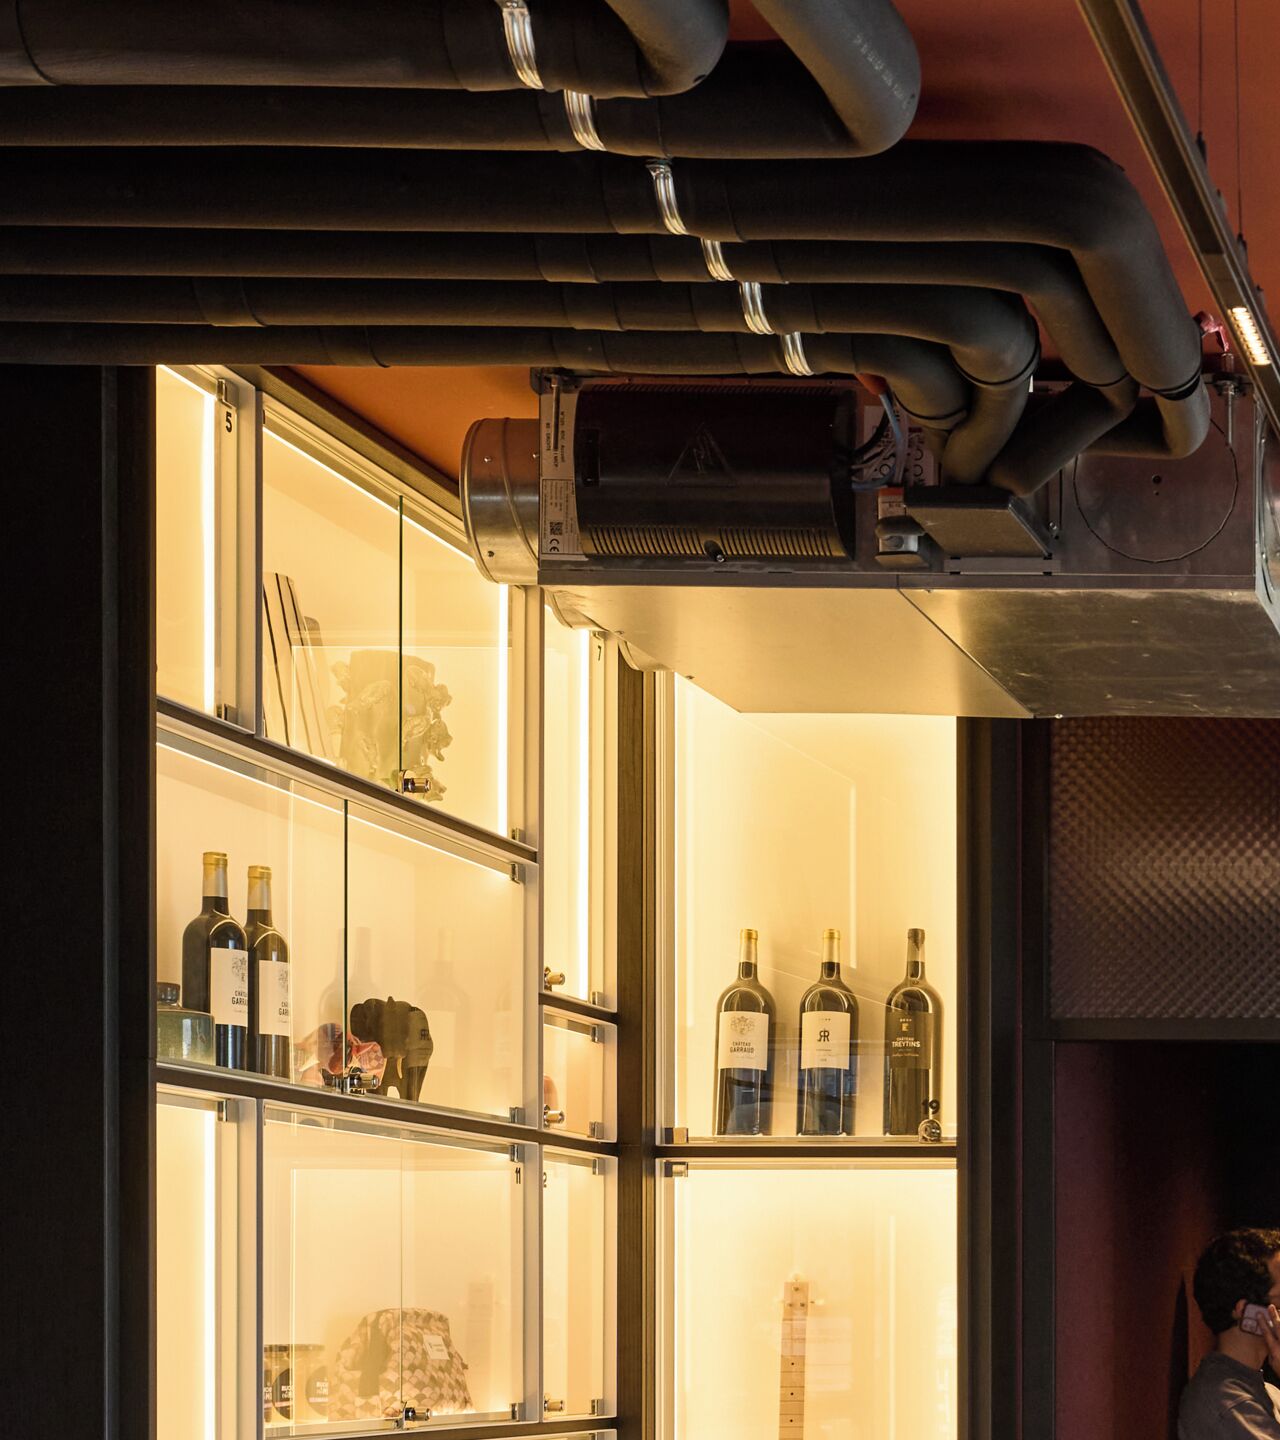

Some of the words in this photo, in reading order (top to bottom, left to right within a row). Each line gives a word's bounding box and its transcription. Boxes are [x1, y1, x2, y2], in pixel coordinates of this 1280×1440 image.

[225, 411, 232, 432] 5
[597, 645, 602, 661] 7
[922, 1099, 940, 1115] 19
[515, 1167, 521, 1184] 11
